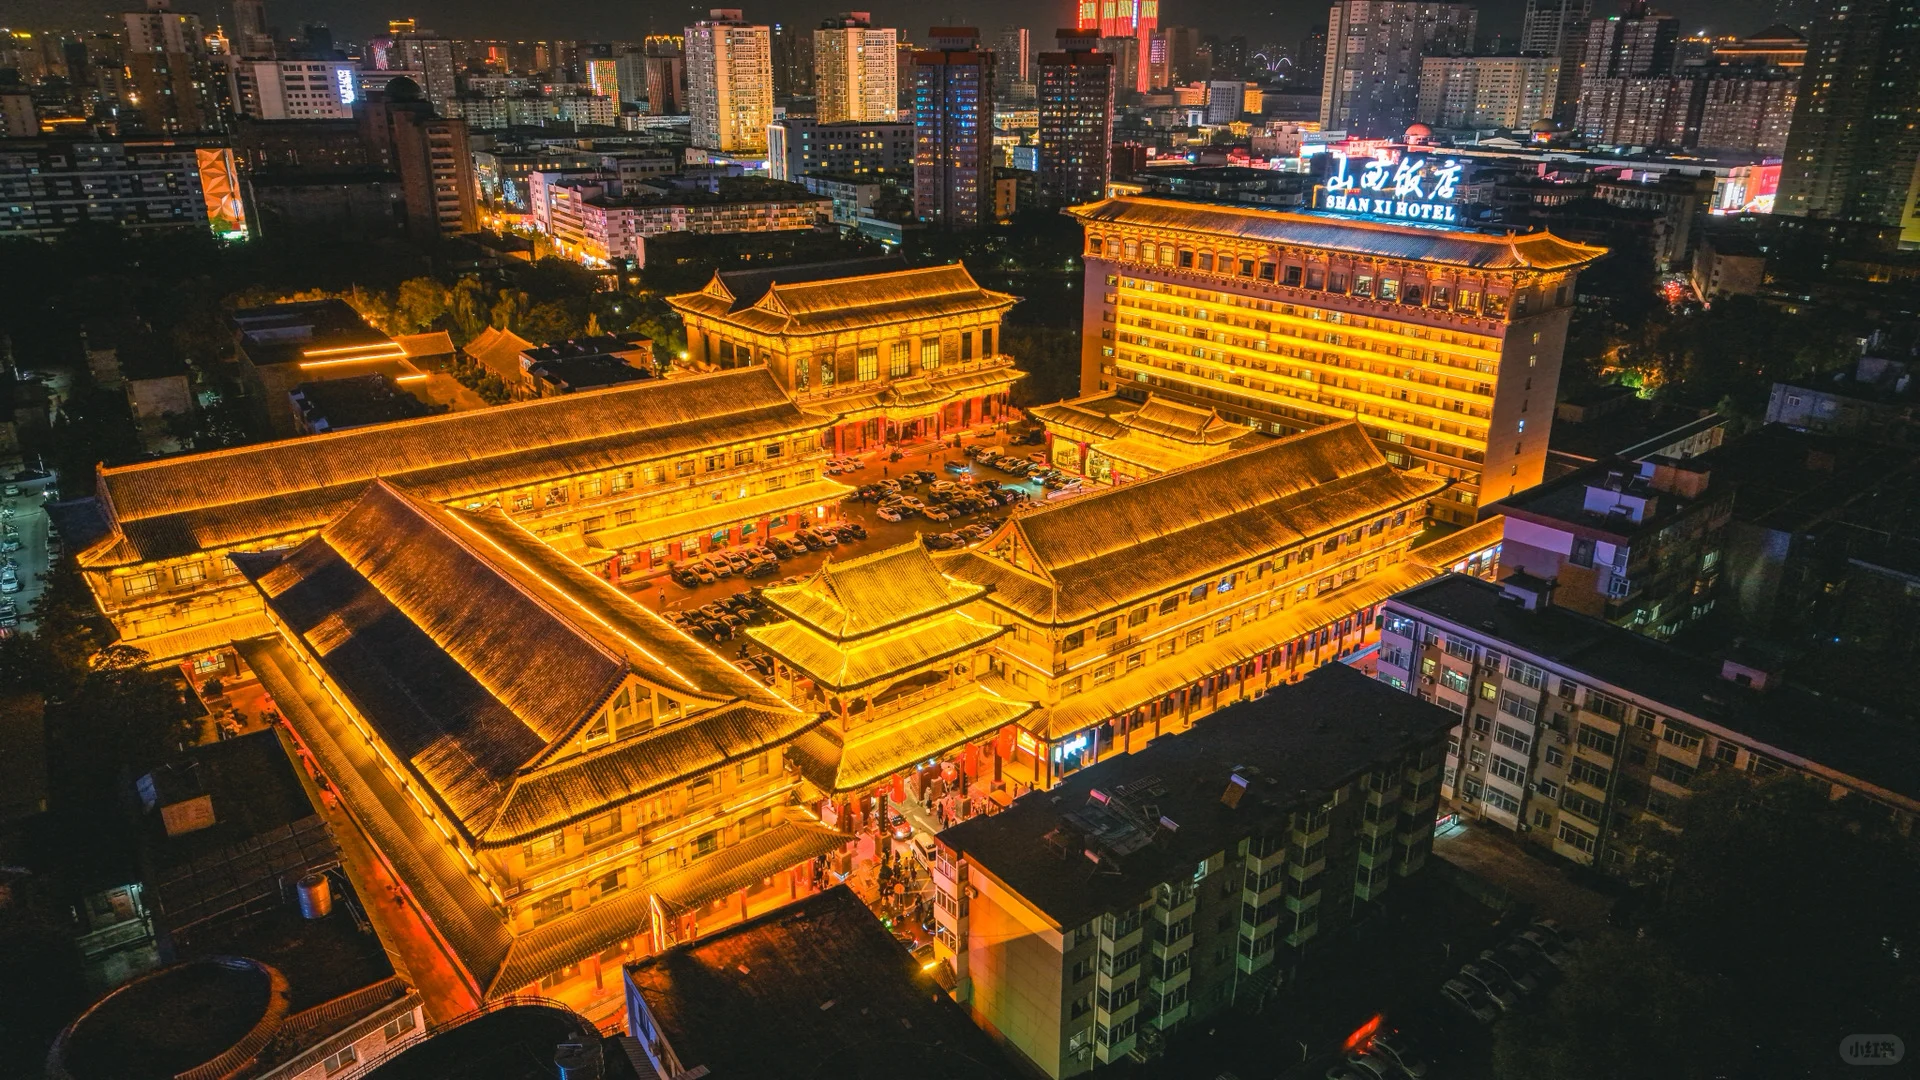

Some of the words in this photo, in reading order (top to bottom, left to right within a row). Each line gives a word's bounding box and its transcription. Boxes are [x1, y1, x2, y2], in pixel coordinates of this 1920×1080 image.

[1326, 152, 1462, 200] 山西饭店
[1326, 195, 1370, 213] SHAN
[1373, 198, 1393, 216] XI
[1395, 201, 1456, 222] HOTEL
